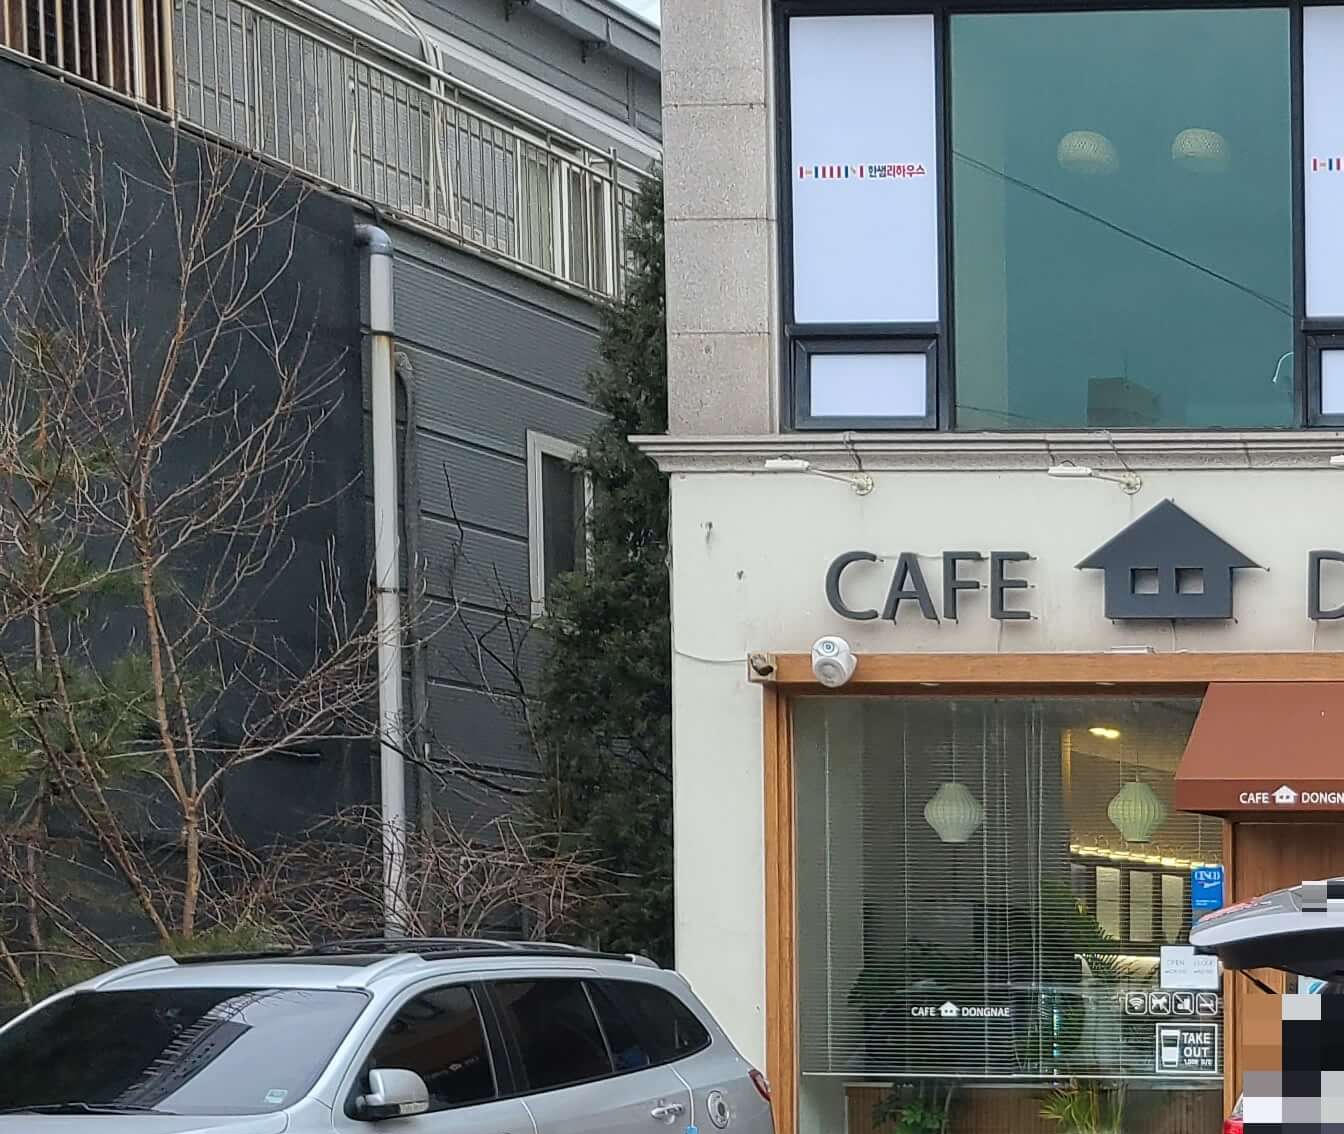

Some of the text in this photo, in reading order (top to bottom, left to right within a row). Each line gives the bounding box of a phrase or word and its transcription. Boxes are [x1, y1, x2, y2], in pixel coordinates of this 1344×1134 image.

[824, 550, 1033, 622] CAFE
[1239, 792, 1270, 804] CAFE
[911, 1006, 1010, 1017] CAFE DONGNAE
[1182, 1032, 1211, 1044] TAKE
[1183, 1046, 1210, 1058] OUT
